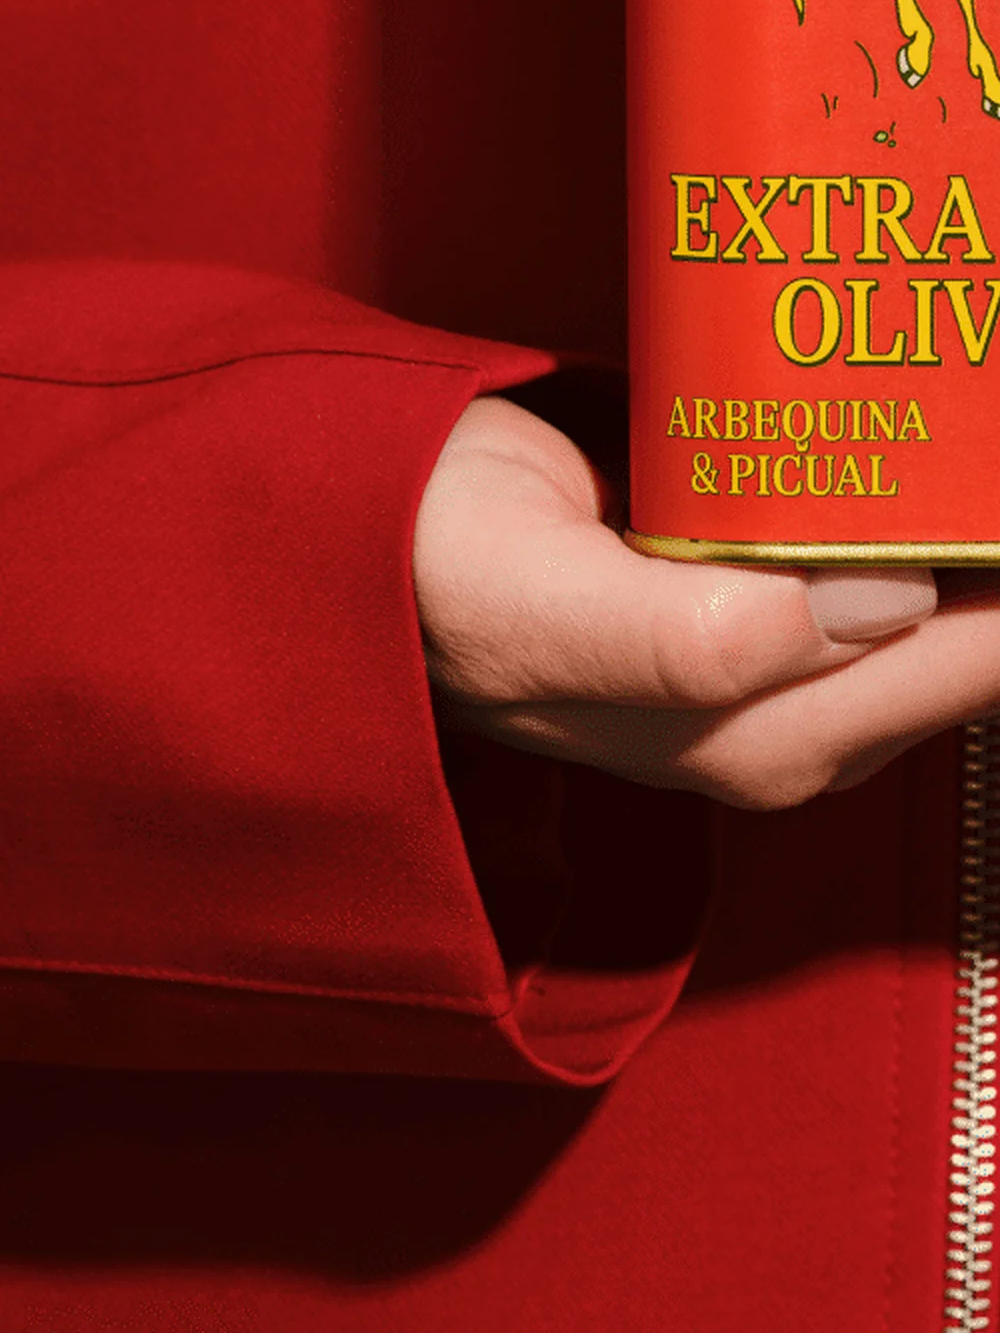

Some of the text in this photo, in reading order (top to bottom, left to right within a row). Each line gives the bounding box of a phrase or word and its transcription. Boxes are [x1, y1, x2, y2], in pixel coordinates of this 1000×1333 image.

[670, 173, 995, 264] EXTRA
[666, 396, 931, 453] ARBEQUINA
[691, 451, 899, 497] & PICUAL
